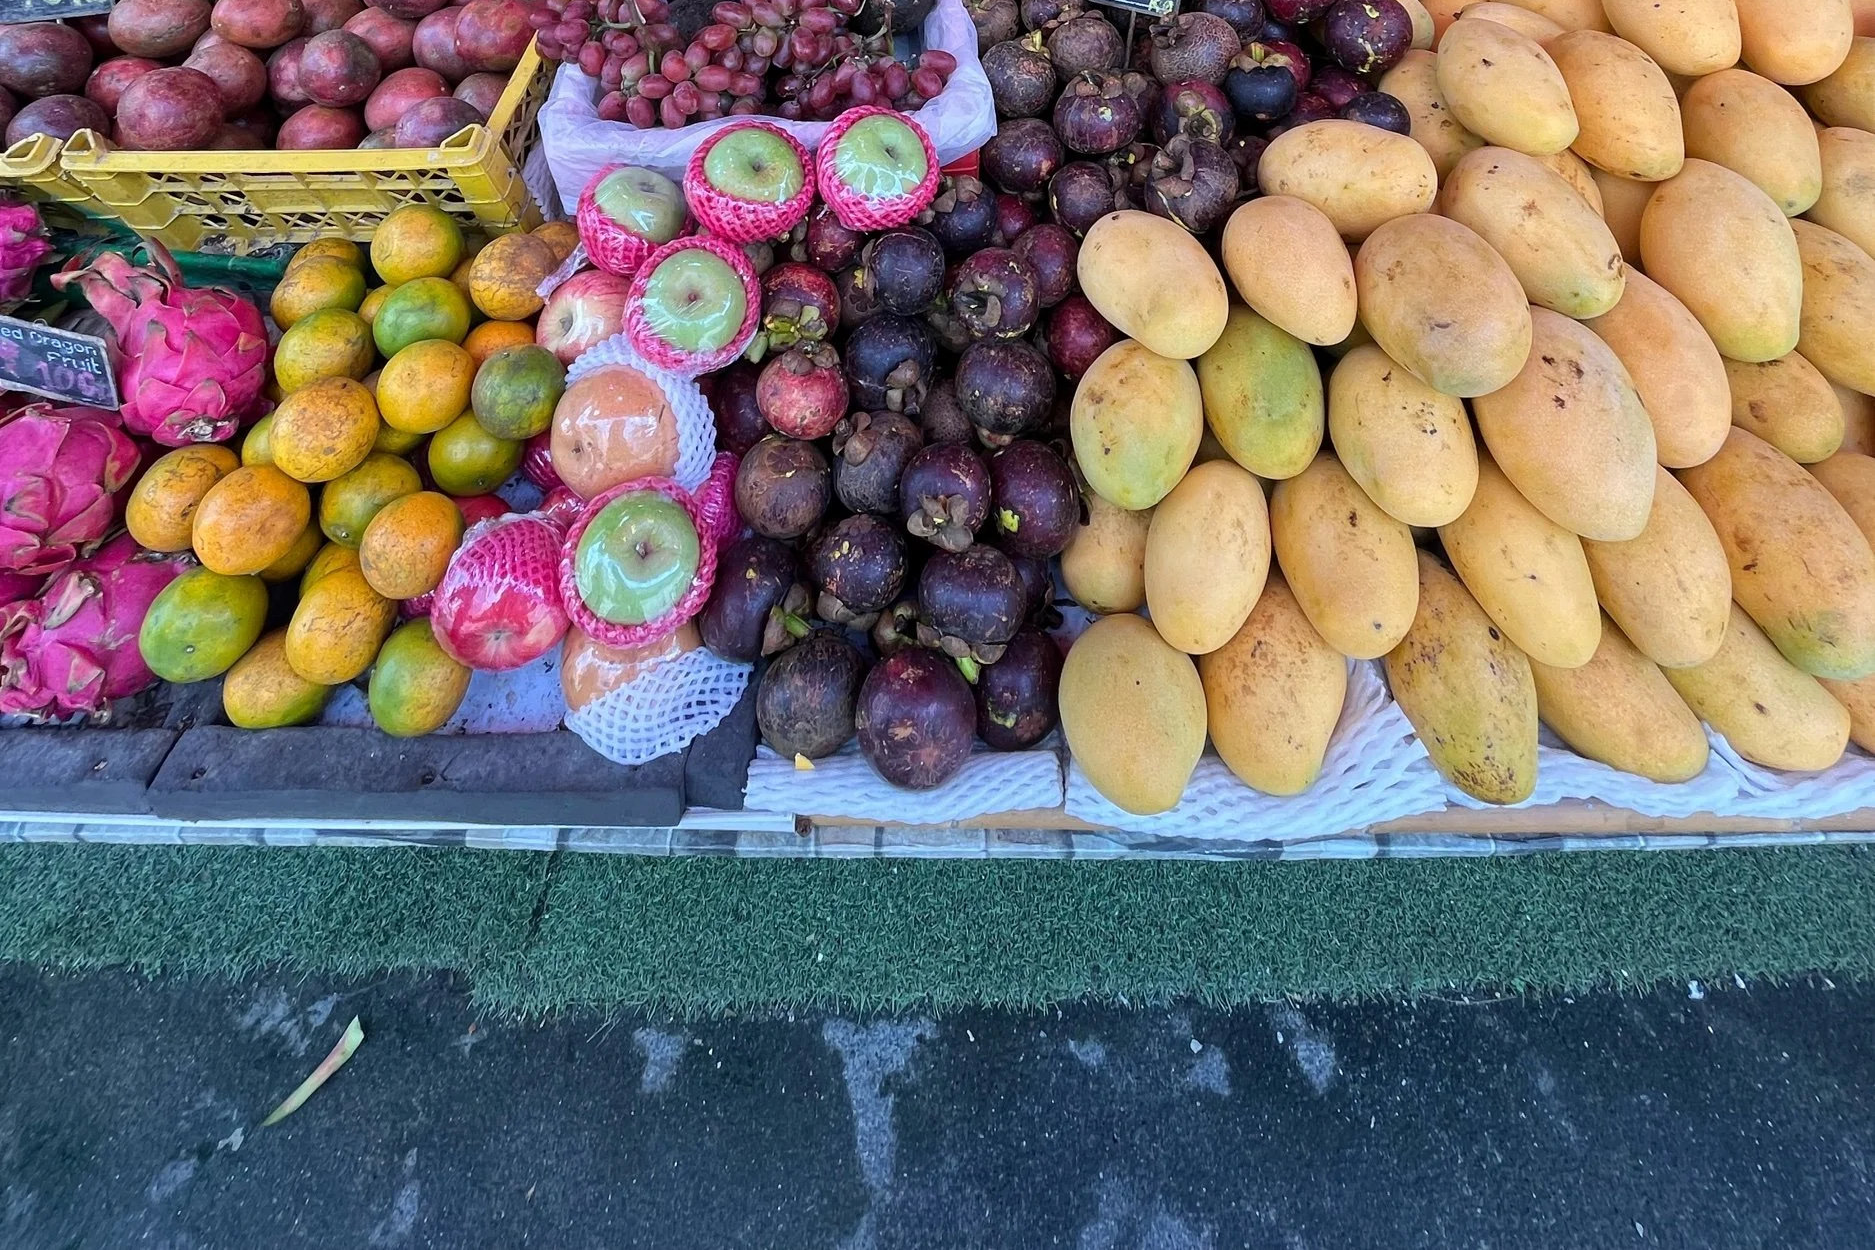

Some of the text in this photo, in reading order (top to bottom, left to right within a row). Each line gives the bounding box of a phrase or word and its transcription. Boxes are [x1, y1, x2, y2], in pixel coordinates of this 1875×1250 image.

[0, 327, 97, 356] ed Dragon
[46, 351, 102, 375] Fruit
